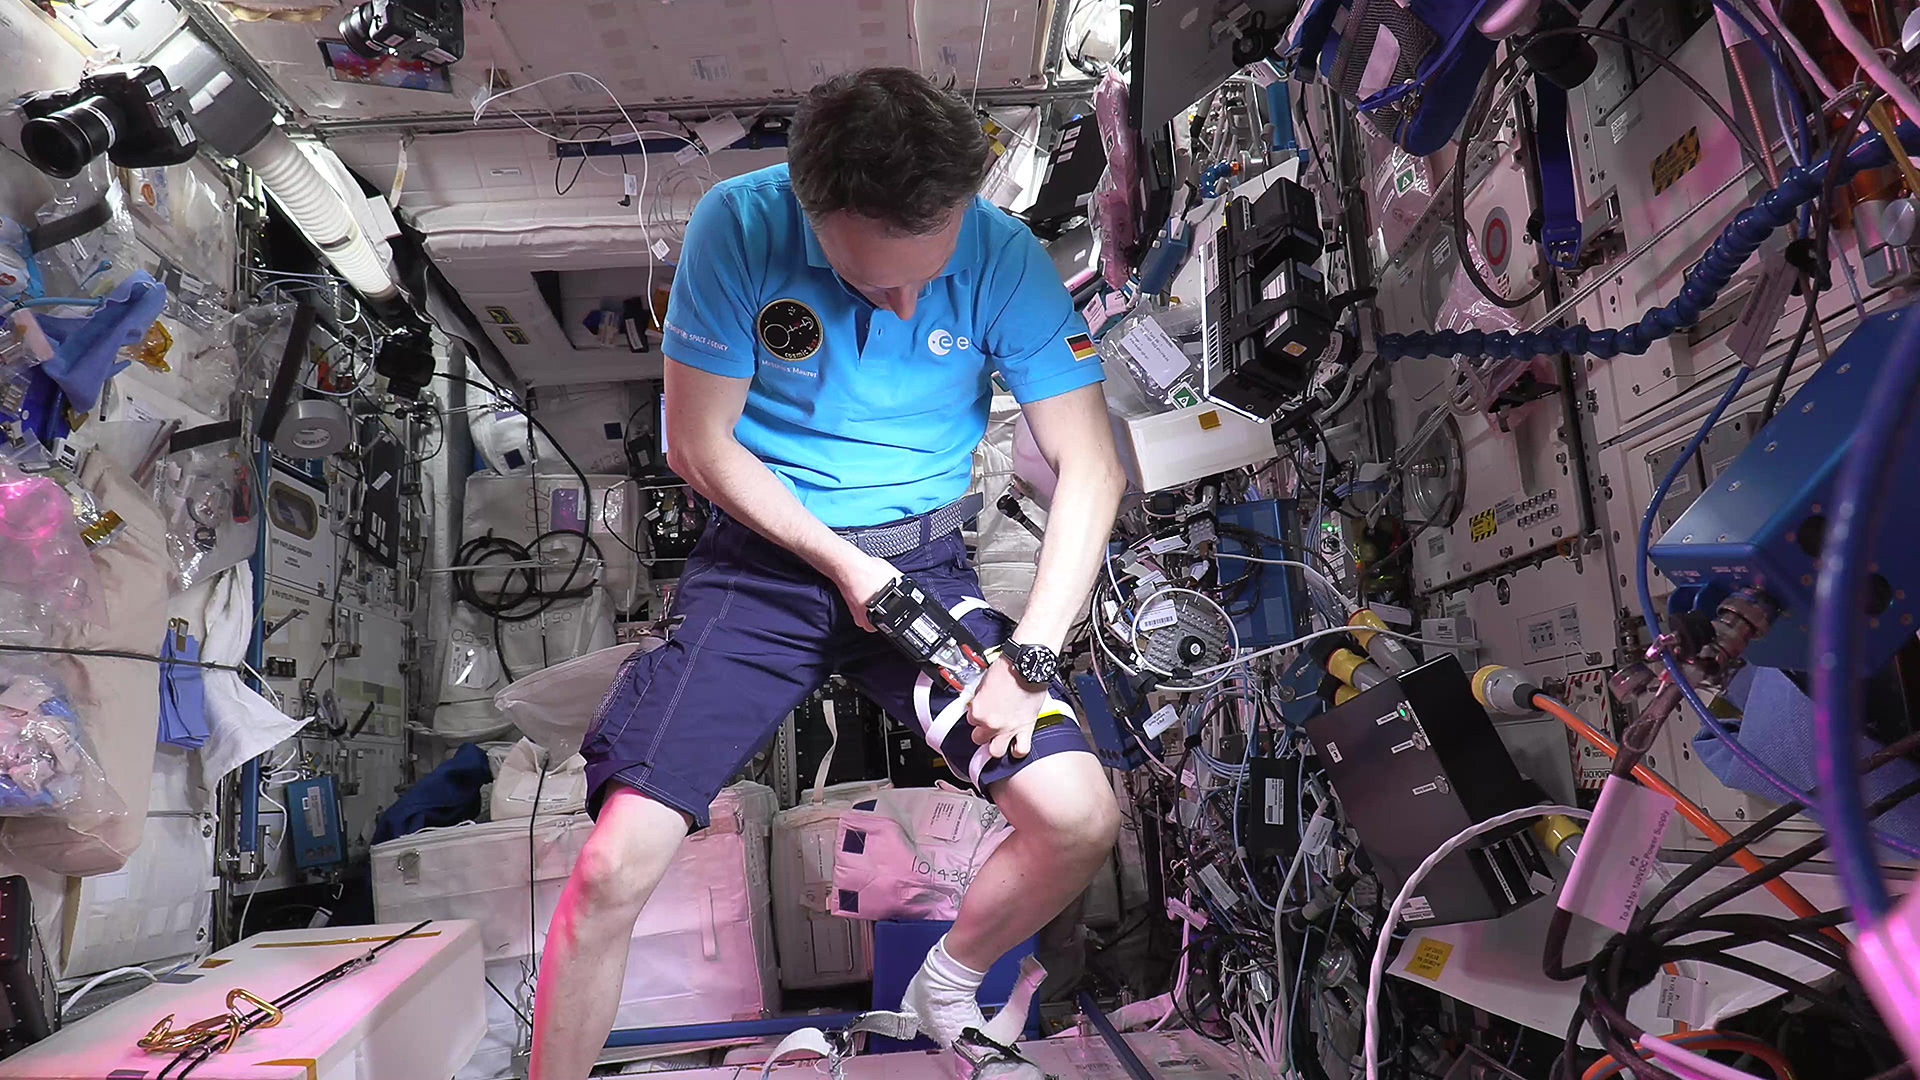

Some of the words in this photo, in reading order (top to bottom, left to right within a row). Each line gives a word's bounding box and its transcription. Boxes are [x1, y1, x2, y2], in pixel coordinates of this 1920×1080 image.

[689, 333, 706, 344] SPACE
[784, 349, 809, 359] cosmic
[792, 366, 818, 379] Maurer
[524, 486, 551, 533] 1002
[1619, 909, 1628, 922] To
[1633, 857, 1649, 890] 120VDC
[1643, 835, 1658, 860] Power
[1653, 810, 1670, 836] Supply
[1629, 855, 1640, 867] P2
